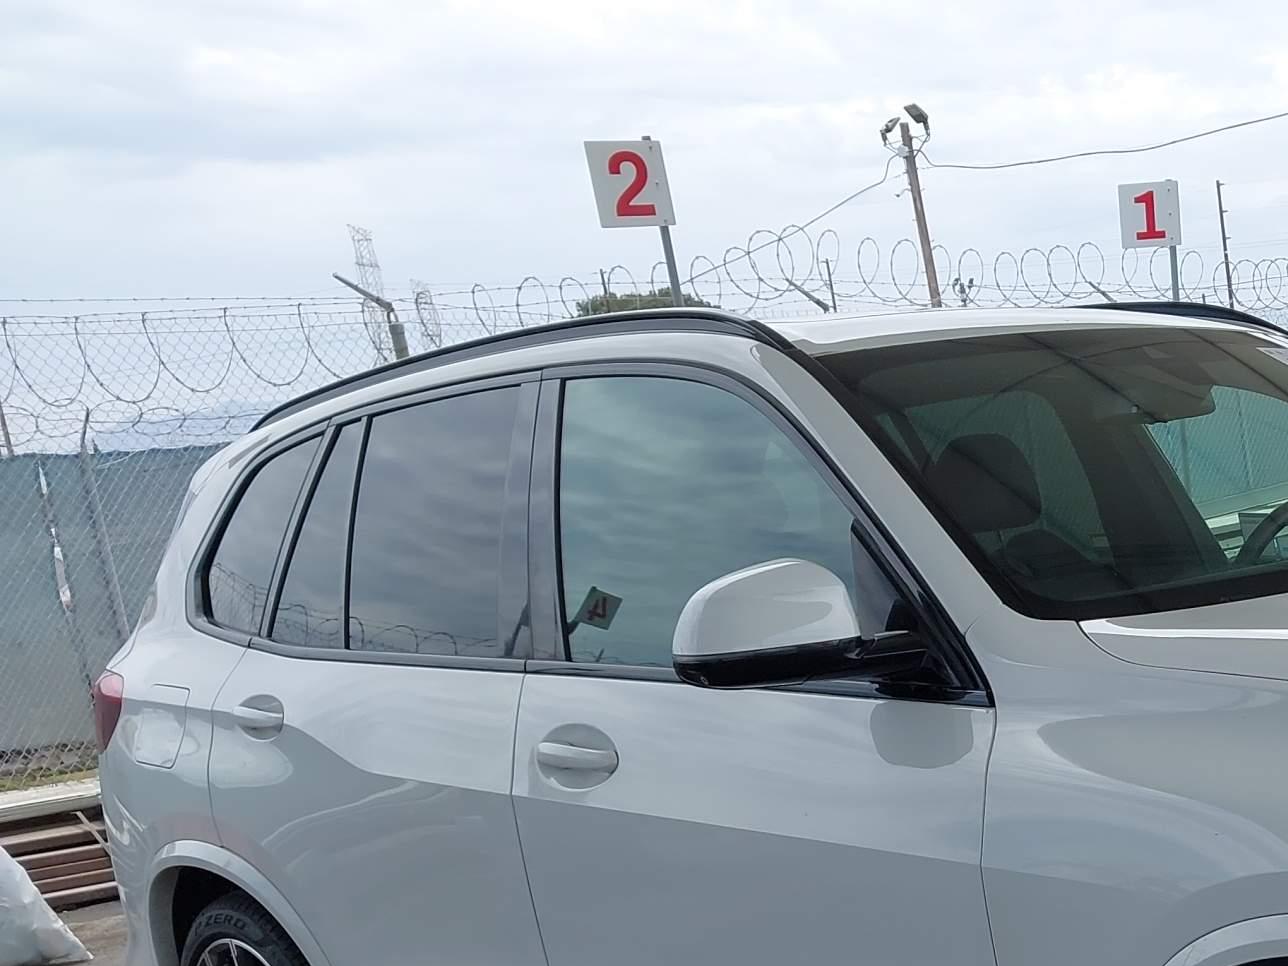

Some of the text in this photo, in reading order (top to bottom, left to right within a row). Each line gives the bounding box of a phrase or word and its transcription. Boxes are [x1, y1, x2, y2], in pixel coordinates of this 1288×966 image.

[608, 150, 657, 217] 2
[1133, 189, 1167, 241] 1
[204, 912, 247, 930] ZERO
